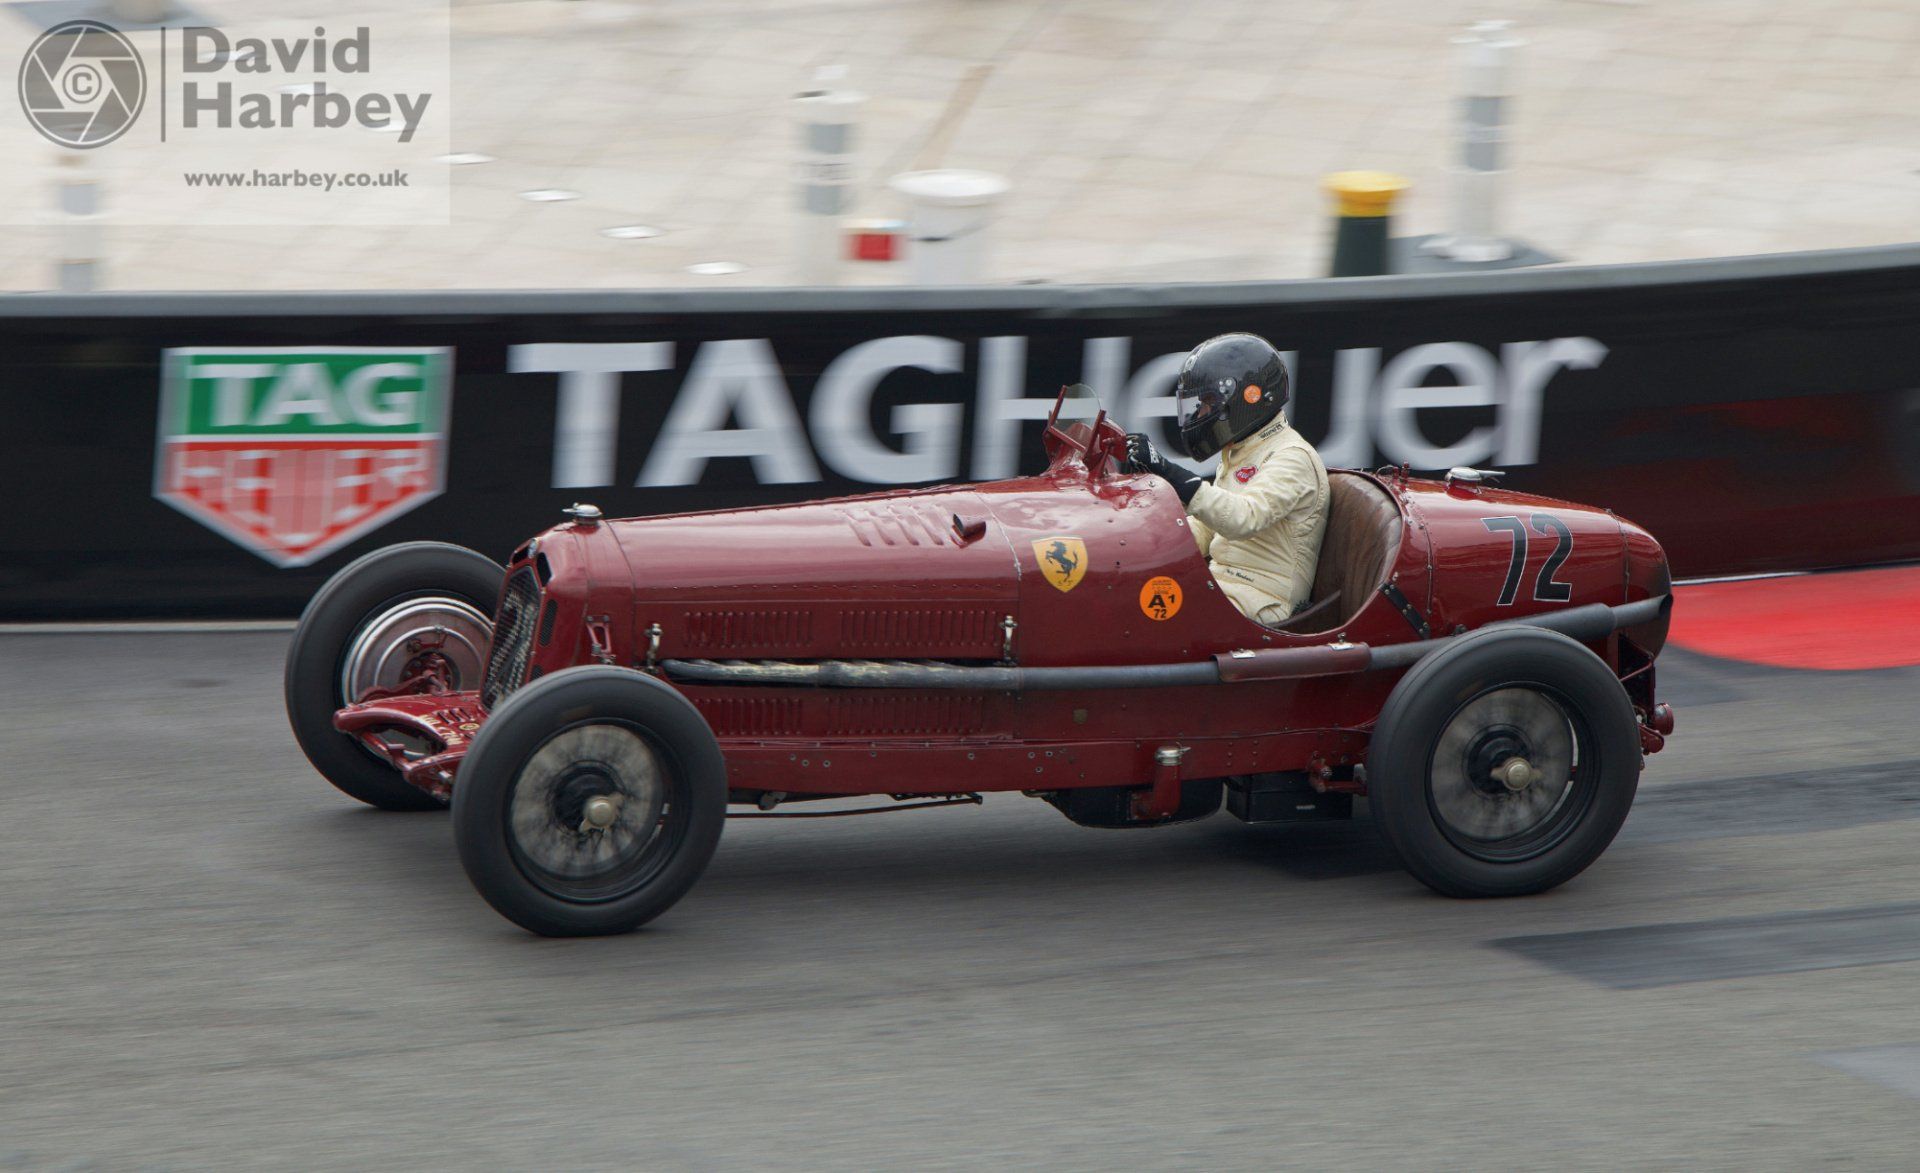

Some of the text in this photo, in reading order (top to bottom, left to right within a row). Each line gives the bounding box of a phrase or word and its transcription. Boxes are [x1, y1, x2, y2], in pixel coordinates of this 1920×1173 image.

[186, 361, 424, 428] TAG
[1480, 511, 1574, 607] 72
[1154, 608, 1167, 619] 72
